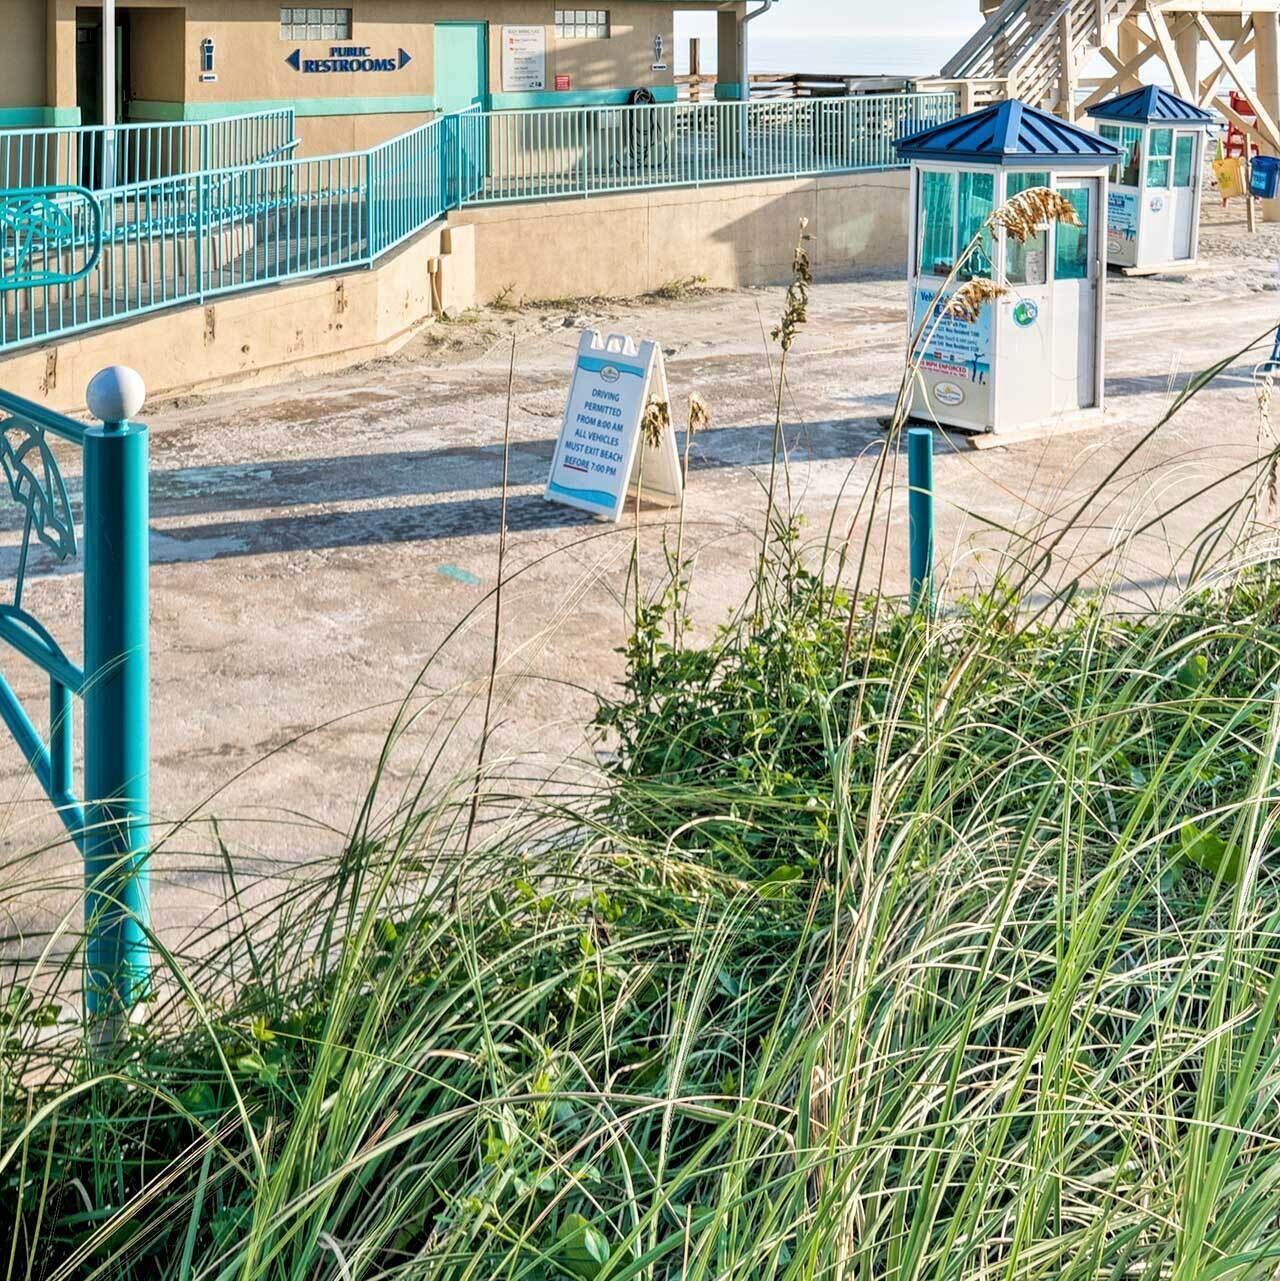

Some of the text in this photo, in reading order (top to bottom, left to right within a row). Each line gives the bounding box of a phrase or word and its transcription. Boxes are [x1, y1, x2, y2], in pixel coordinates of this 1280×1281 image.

[329, 47, 371, 58] PUBLIC
[303, 58, 397, 73] RESTROOMS
[592, 388, 620, 401] DRIVING
[584, 401, 622, 417] PERMITTED
[577, 414, 596, 426] FROM
[612, 423, 624, 432] AM
[575, 429, 619, 446] ALL VEHICLES
[565, 441, 623, 462] MUST EXIT BEACH
[565, 455, 617, 475] BEFORE 7:00 PM
